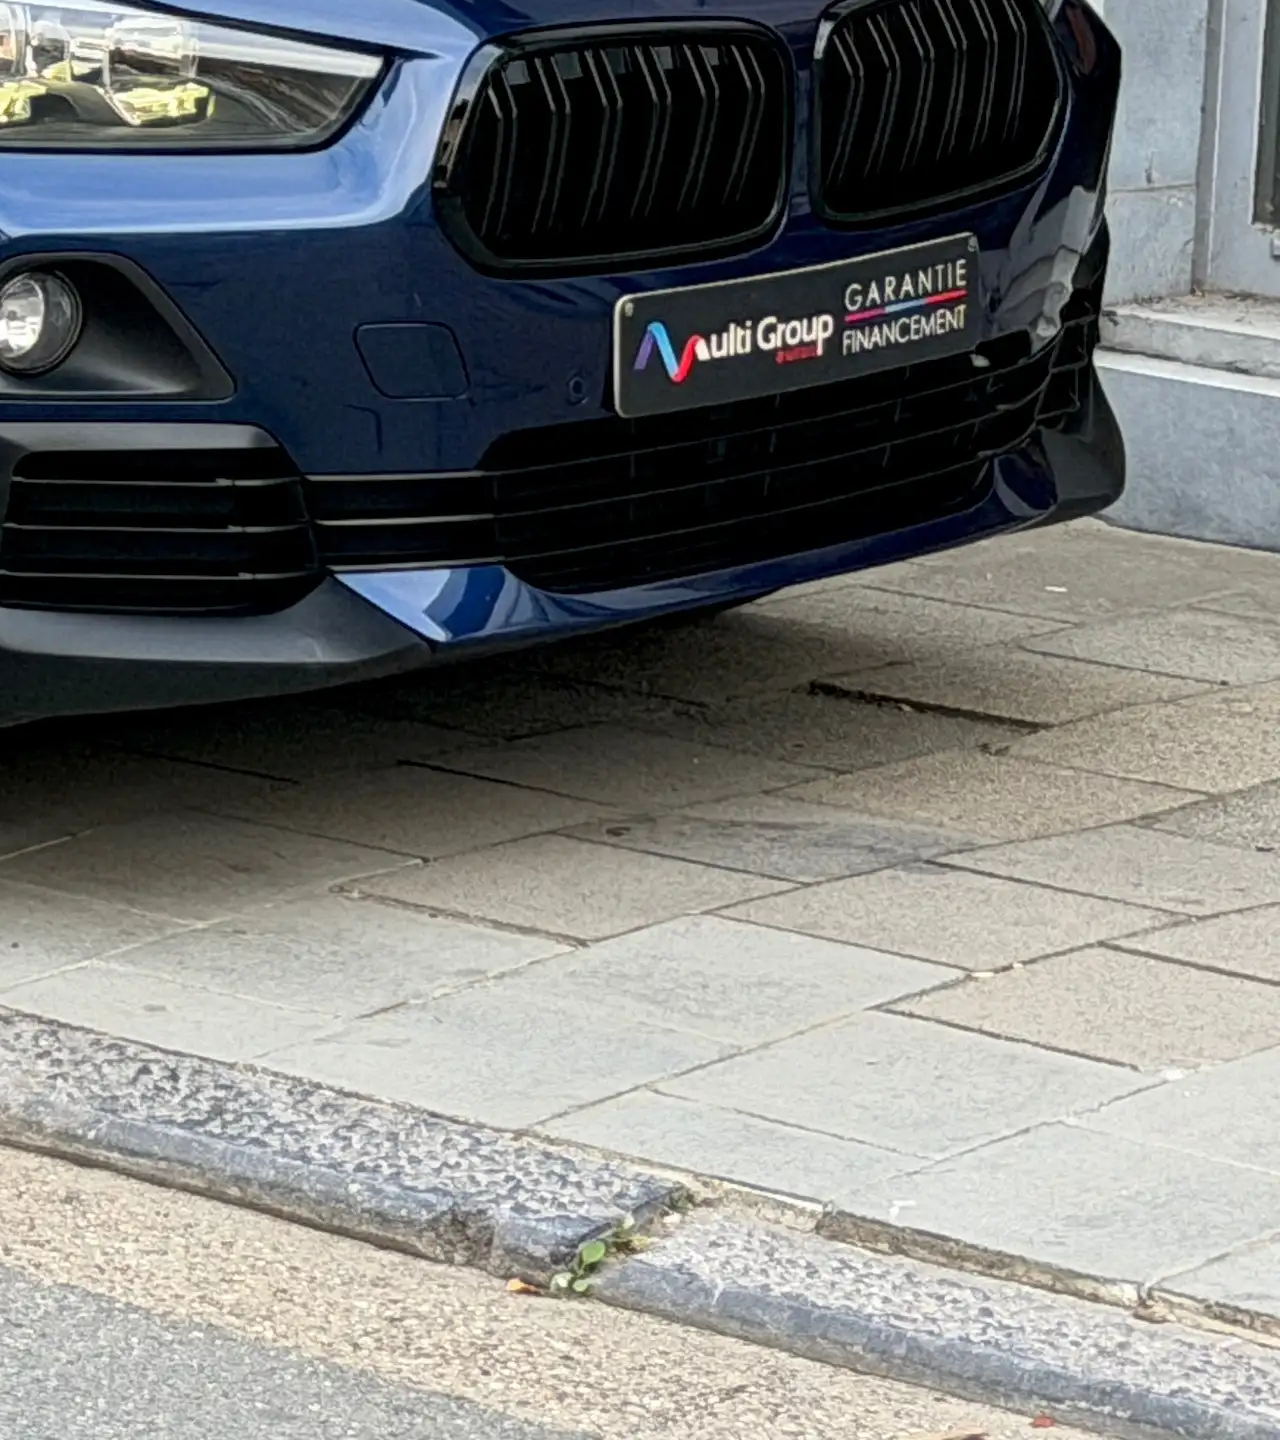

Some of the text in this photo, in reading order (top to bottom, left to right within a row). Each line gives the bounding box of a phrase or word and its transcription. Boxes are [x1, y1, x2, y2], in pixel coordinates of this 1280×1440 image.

[845, 260, 968, 311] GARANTIE
[633, 313, 835, 384] Multi Group
[842, 304, 968, 357] FINANCEMENT
